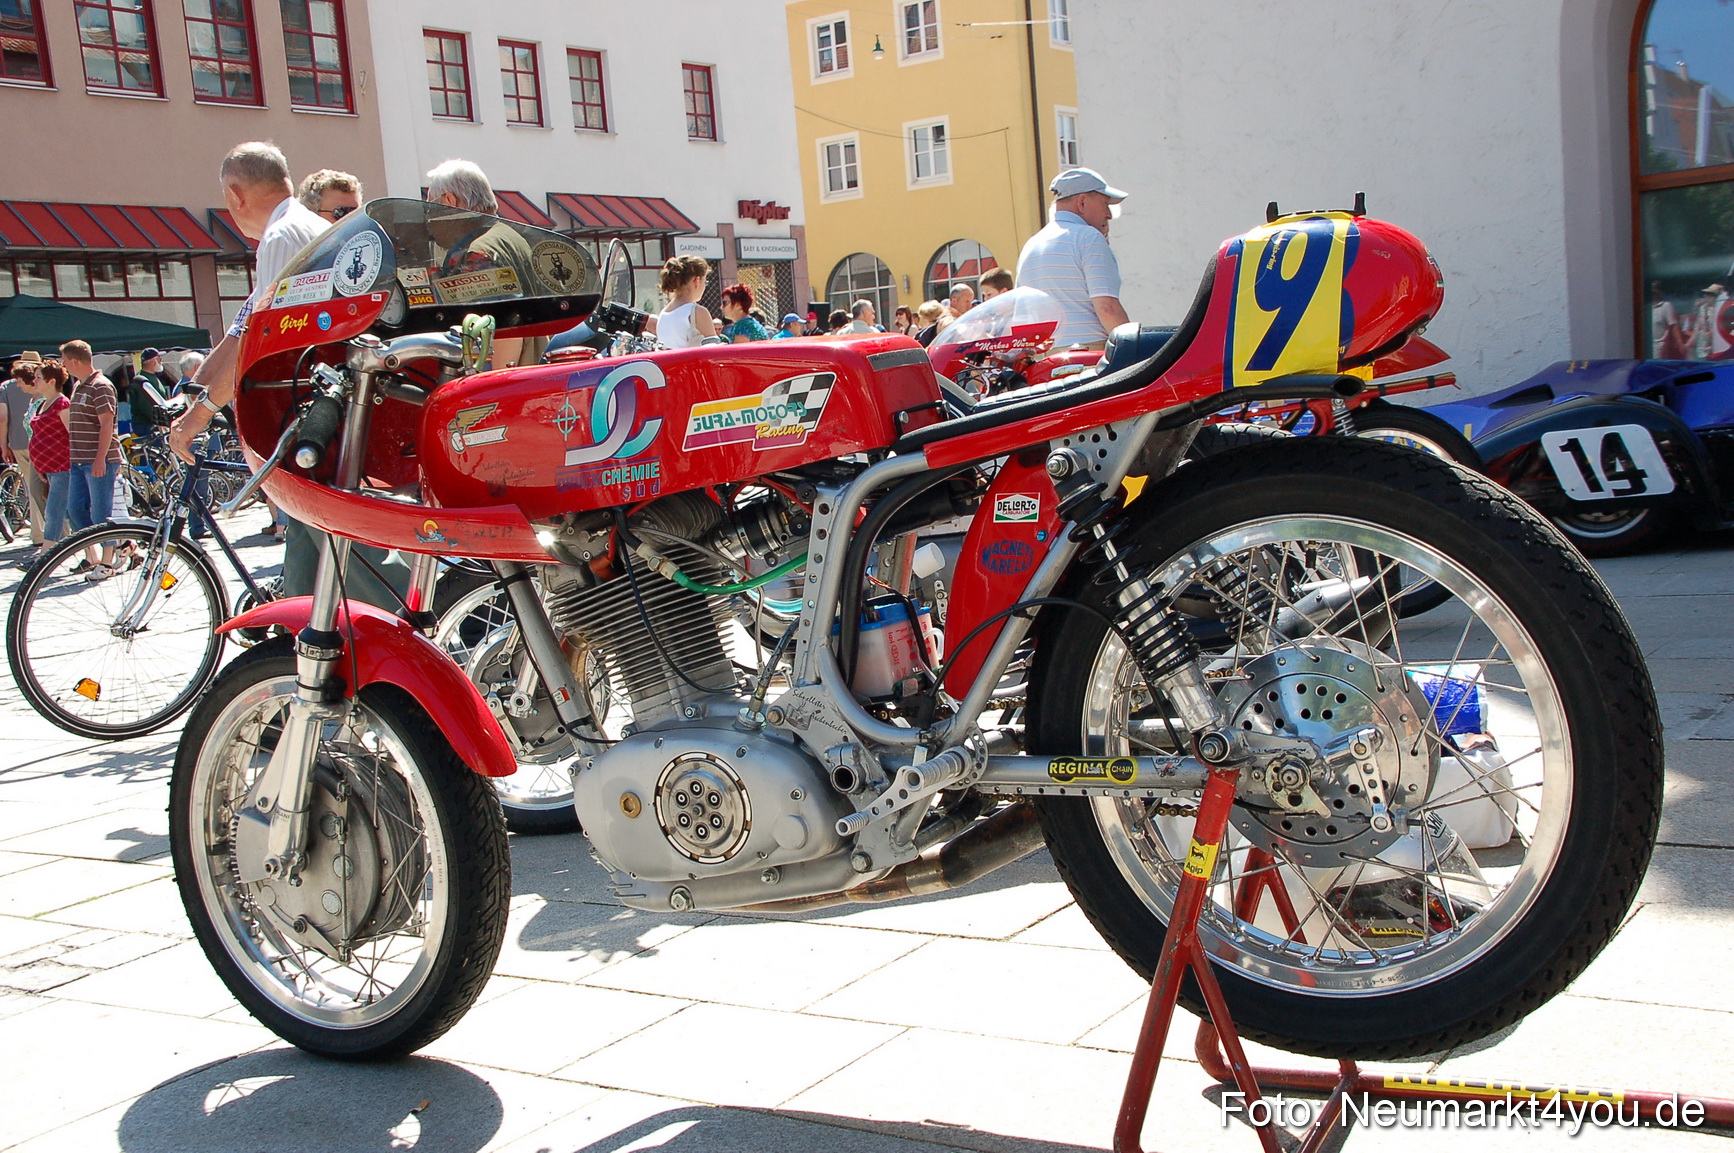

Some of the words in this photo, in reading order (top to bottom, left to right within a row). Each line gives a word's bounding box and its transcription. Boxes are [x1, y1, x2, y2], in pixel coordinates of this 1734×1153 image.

[680, 244, 707, 252] GARDINEN
[293, 272, 330, 288] DUCATI
[280, 312, 309, 334] Girgl
[755, 423, 805, 440] Racing
[1558, 421, 1649, 497] 14
[622, 479, 660, 500] süd
[982, 540, 1034, 560] MAGNETI
[981, 556, 1034, 575] MARELLI
[1049, 762, 1105, 775] REGINA
[1111, 765, 1133, 773] CHAIN
[1186, 862, 1204, 874] Agip
